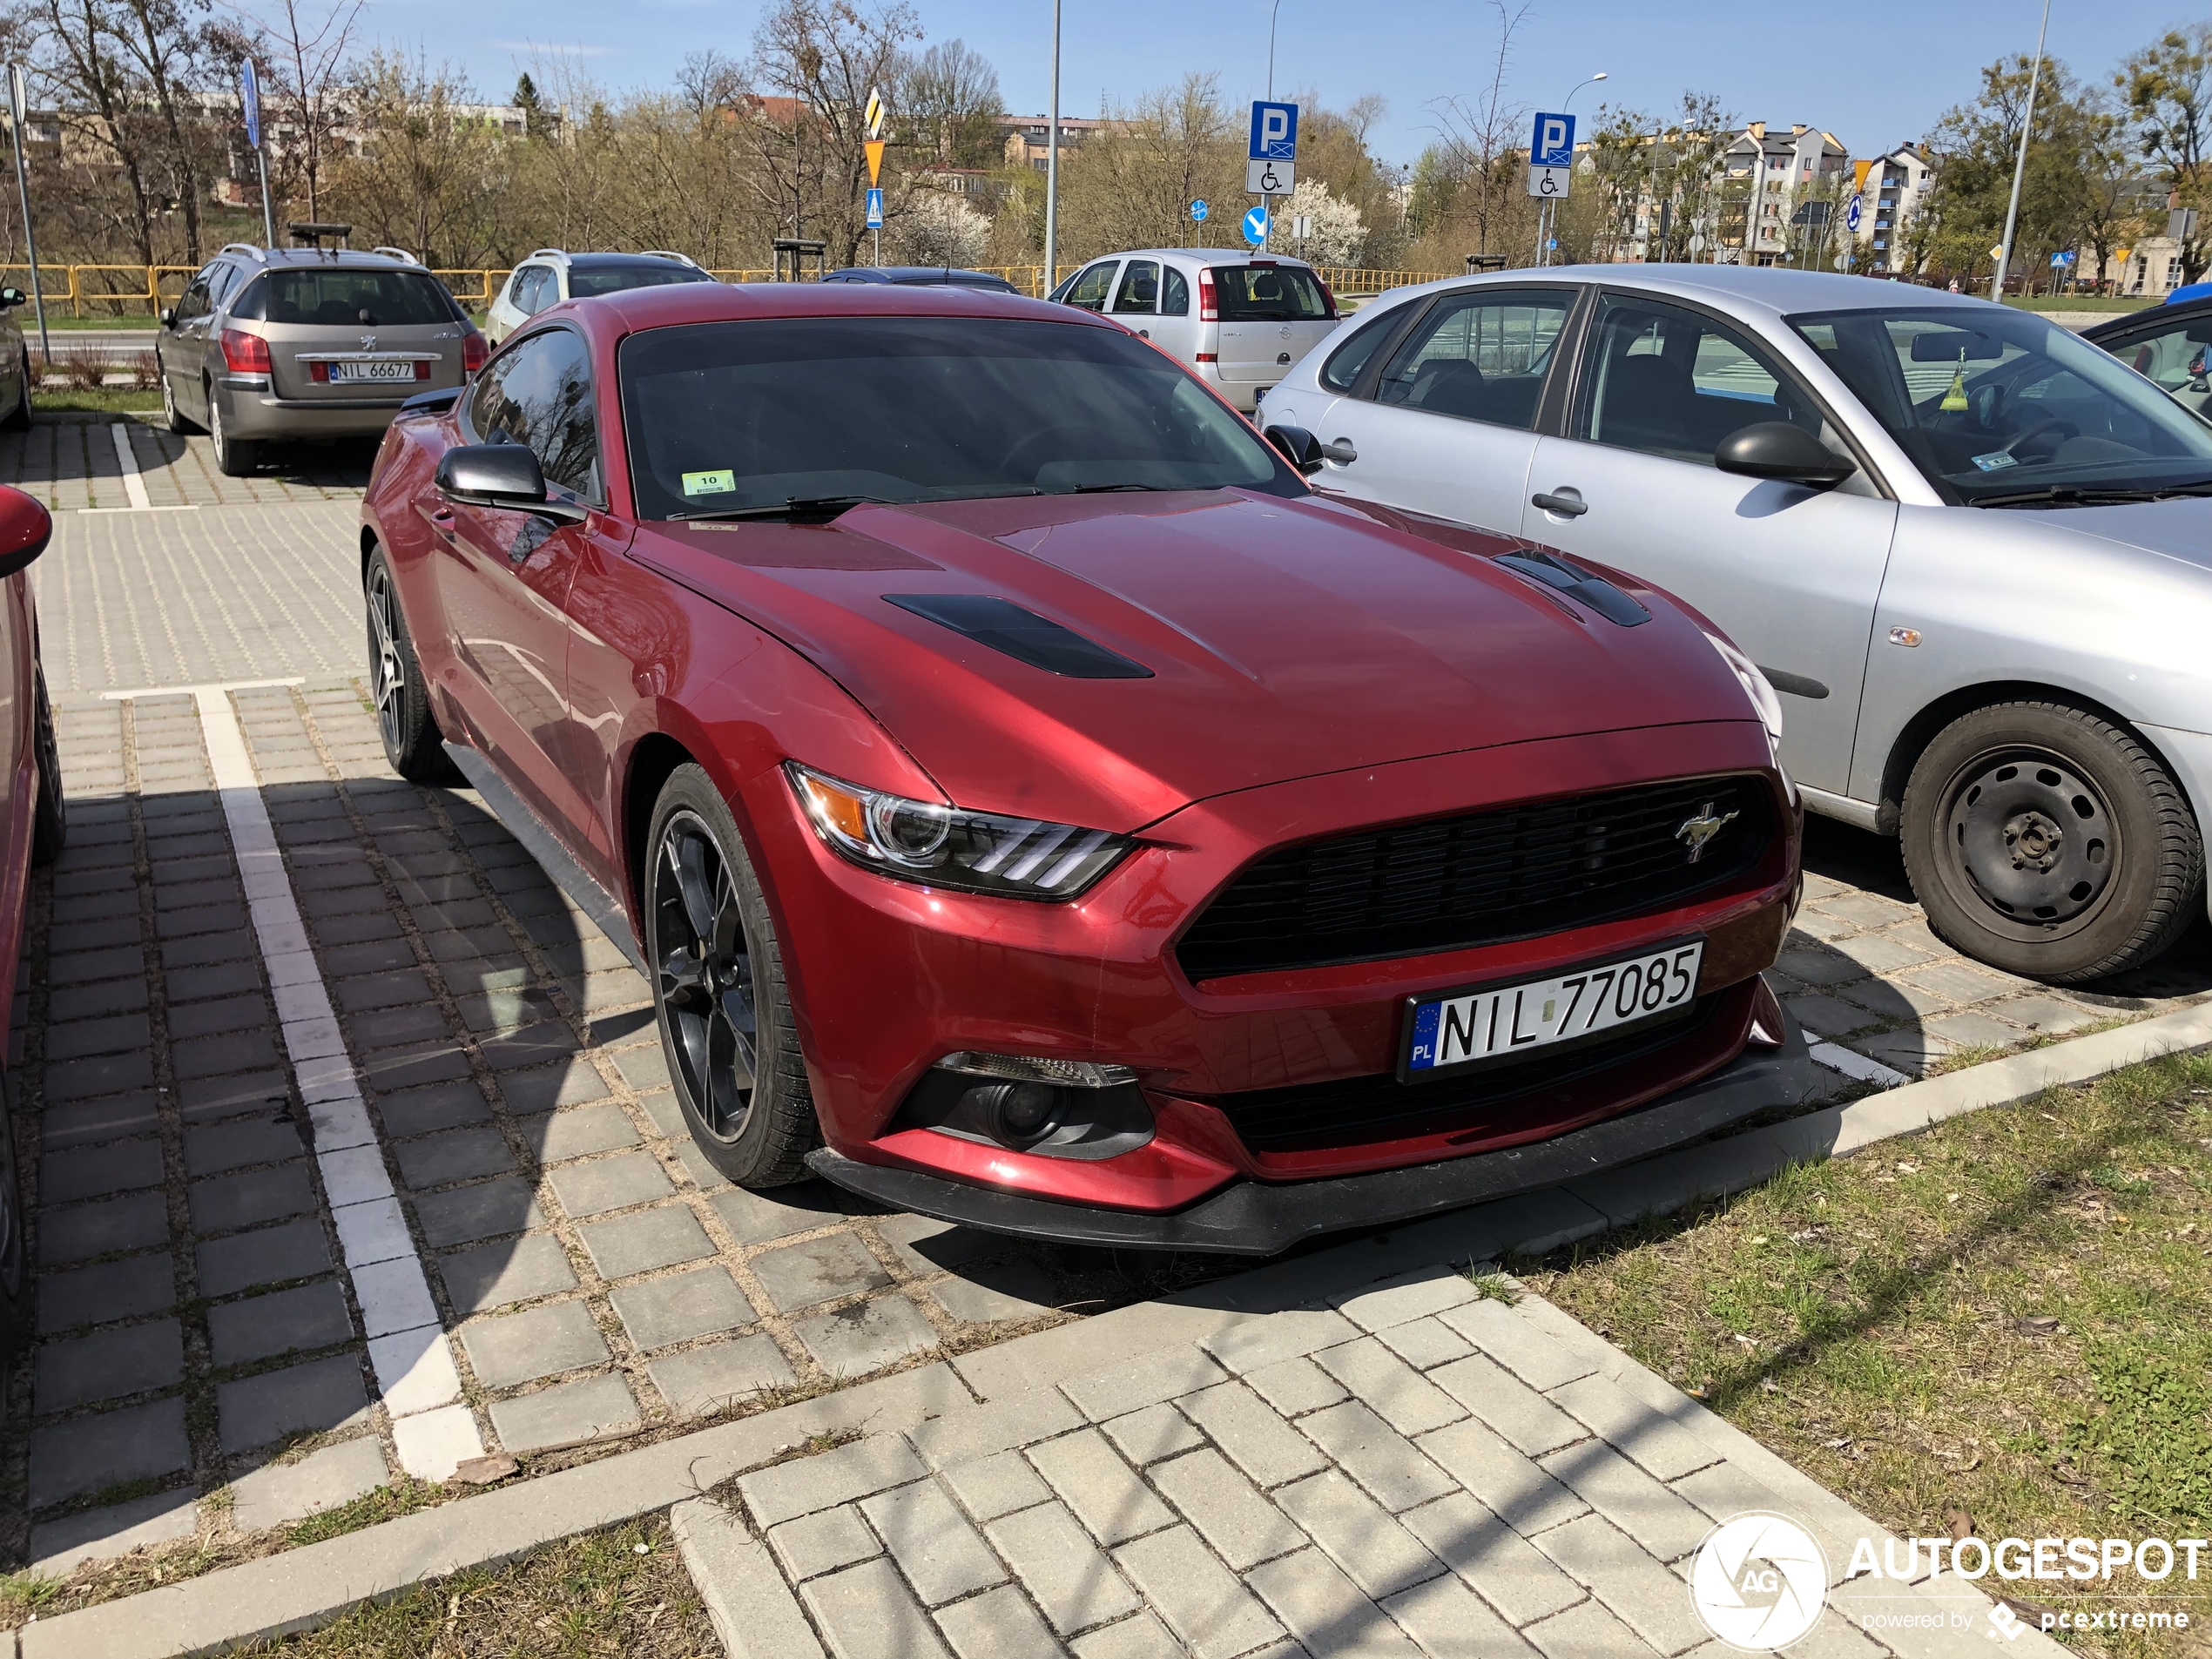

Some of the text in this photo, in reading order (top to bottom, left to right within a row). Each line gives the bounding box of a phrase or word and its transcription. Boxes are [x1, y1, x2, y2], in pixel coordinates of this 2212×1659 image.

[1260, 107, 1289, 152] P
[1540, 118, 1567, 159] P
[338, 362, 411, 378] NIL 66677
[701, 476, 718, 485] 10
[1440, 948, 1696, 1061] NIL 77085
[1412, 1044, 1432, 1062] PL
